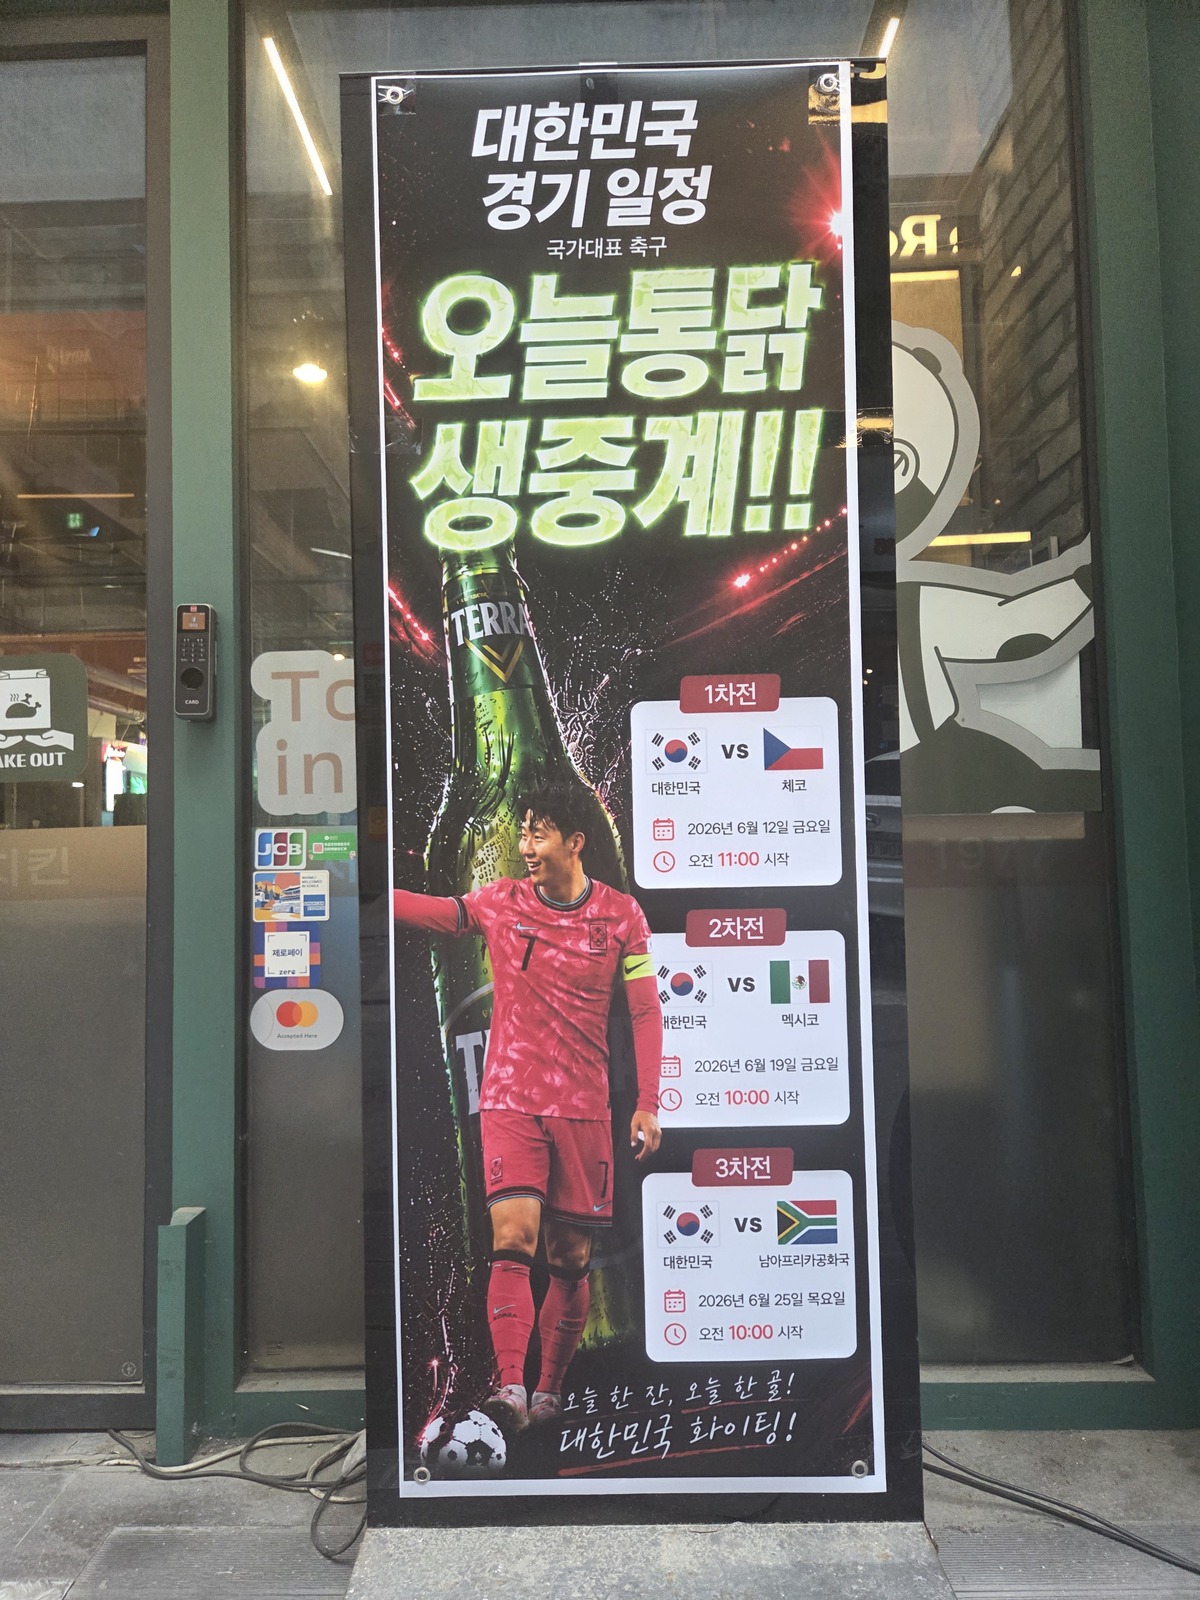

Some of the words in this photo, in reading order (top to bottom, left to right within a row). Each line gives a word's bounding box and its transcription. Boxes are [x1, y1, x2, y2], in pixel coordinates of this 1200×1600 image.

[471, 100, 699, 163] 대한민국
[482, 169, 591, 231] 경기
[606, 165, 712, 227] 일정
[546, 238, 623, 260] 국가대표
[629, 236, 668, 258] 축구
[411, 261, 823, 402] 오늘통닭
[410, 408, 825, 552] 생중계!!
[451, 602, 533, 646] TERRA
[704, 682, 757, 706] 1차전
[30, 752, 66, 767] OUT
[276, 738, 344, 796] in
[651, 781, 701, 795] 대한민국
[782, 779, 807, 792] 체코
[687, 821, 733, 835] 2026년
[737, 821, 758, 835] 6월
[762, 820, 789, 834] 12일
[792, 819, 831, 833] 금요일
[258, 843, 302, 856] JCB
[688, 854, 713, 868] 오전
[718, 852, 760, 867] 11:00
[764, 851, 789, 866] 시작
[709, 916, 764, 940] 2차전
[272, 949, 303, 957] 제로페이
[519, 934, 538, 971] 7
[781, 1012, 819, 1028] 멕시코
[694, 1058, 740, 1073] 2026년
[744, 1058, 766, 1072] 6월
[769, 1057, 797, 1072] 19일
[800, 1056, 839, 1072] 금요일
[695, 1091, 720, 1106] 오전
[724, 1090, 770, 1105] 10:00
[774, 1090, 800, 1105] 시작
[715, 1155, 771, 1180] 3차전
[663, 1255, 713, 1270] 대한민국
[758, 1253, 850, 1268] 남아프리카공화국
[698, 1293, 745, 1308] 2026년
[749, 1293, 770, 1307] 6월
[774, 1292, 803, 1306] 25일
[807, 1291, 846, 1306] 목요일
[699, 1327, 724, 1341] 오전
[728, 1325, 774, 1340] 10:00
[777, 1325, 803, 1340] 시작
[563, 1387, 598, 1415] 오늘
[610, 1385, 633, 1410] 한
[645, 1383, 673, 1407] 잔,
[685, 1377, 722, 1406] 오늘
[734, 1376, 758, 1400] 한
[766, 1369, 796, 1403] 골!
[559, 1413, 673, 1460] 대한민국
[689, 1411, 797, 1445] 화이팅!
